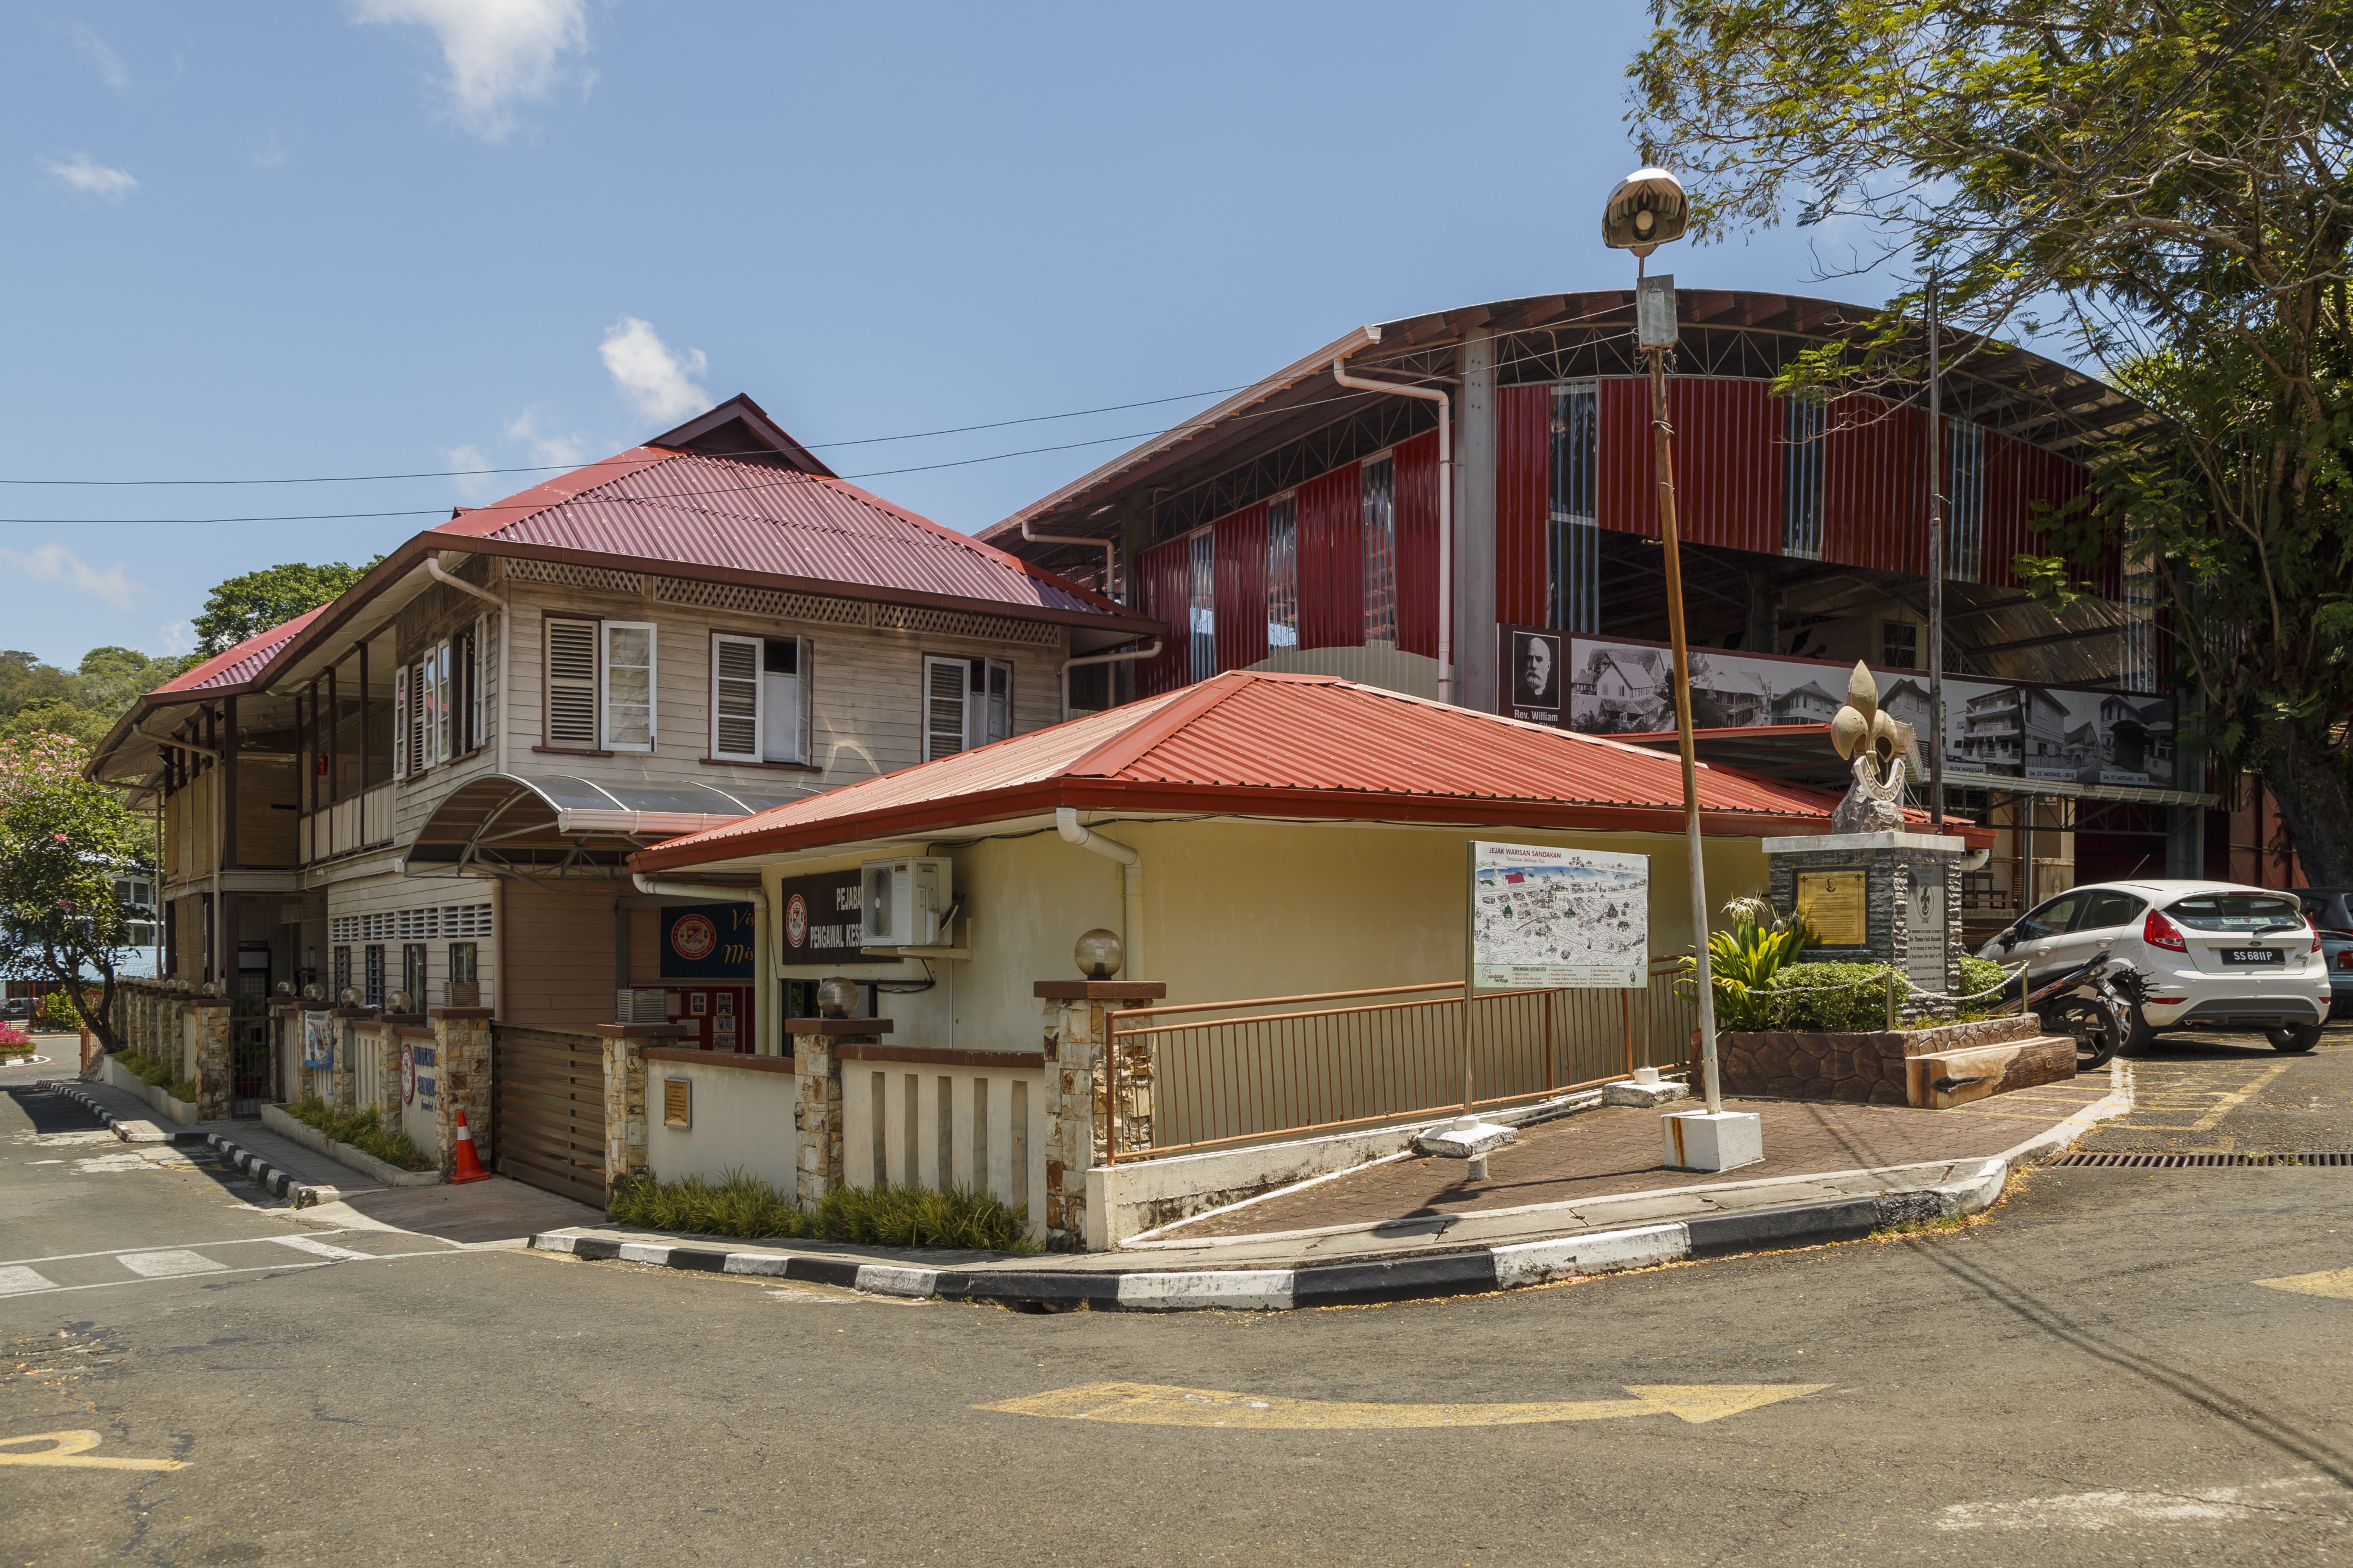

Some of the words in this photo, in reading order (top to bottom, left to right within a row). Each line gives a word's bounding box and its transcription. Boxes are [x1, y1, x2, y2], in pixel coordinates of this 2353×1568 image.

[1514, 709, 1529, 719] Rev.
[1531, 710, 1558, 722] William
[1865, 769, 1878, 792] BOY
[1880, 770, 1902, 800] SCOUTS
[1532, 850, 1561, 859] SANDAKAN
[836, 886, 862, 911] PEJABA
[732, 909, 755, 932] Vis
[810, 925, 844, 949] PENGAWAL
[721, 945, 754, 964] Mis
[2234, 952, 2246, 960] SS
